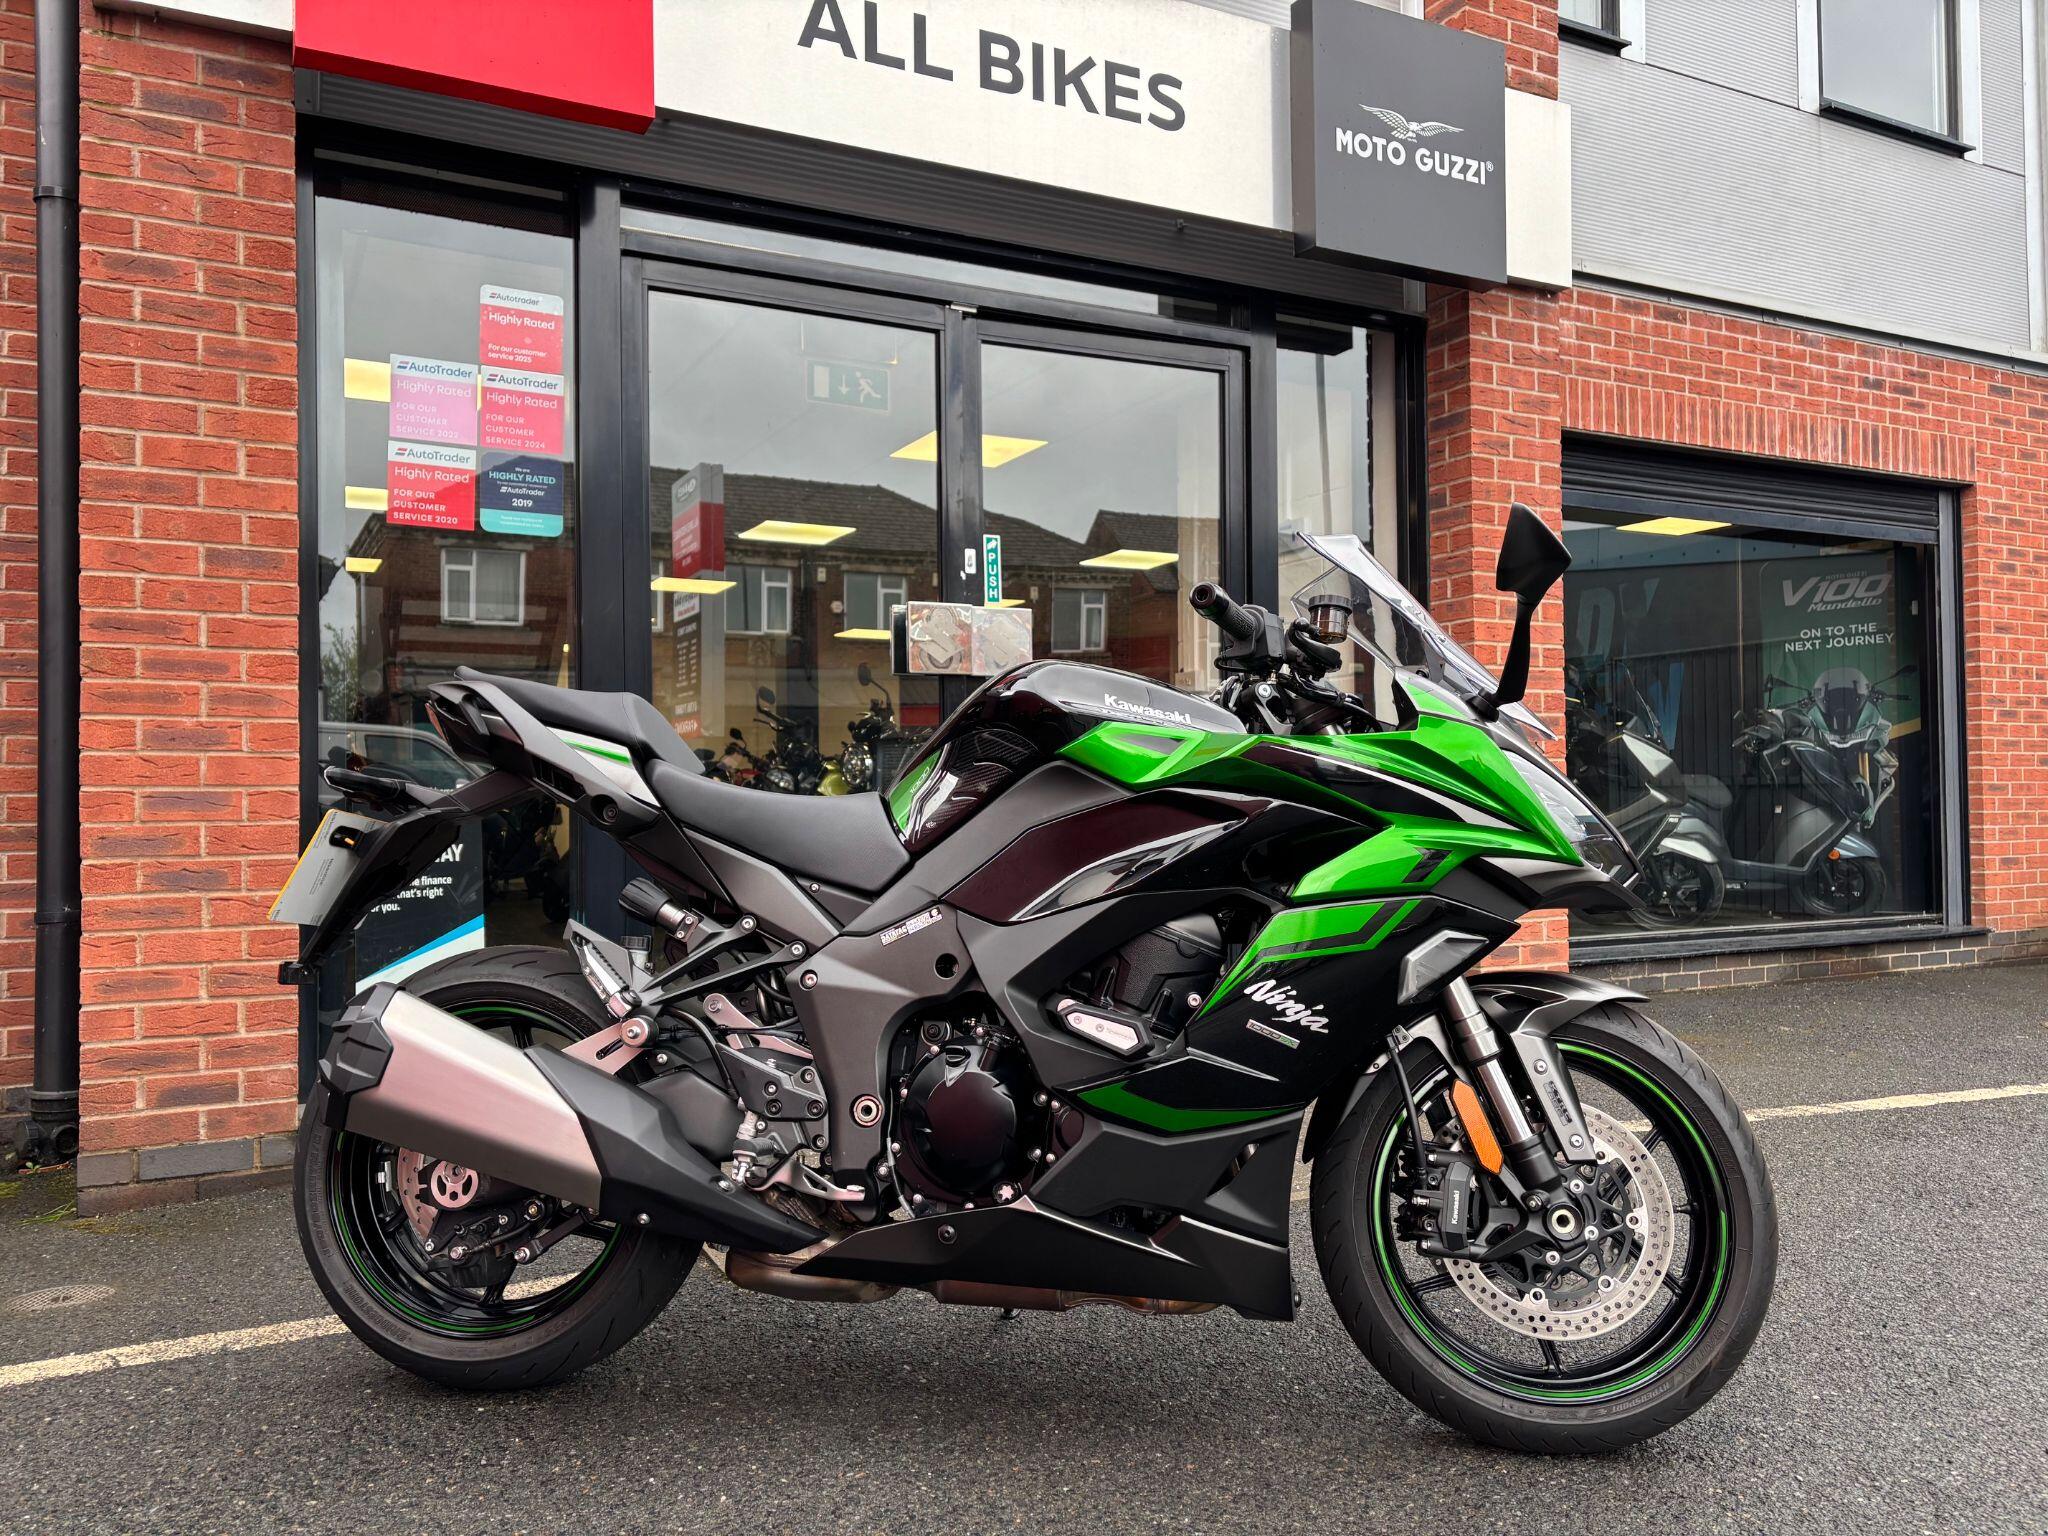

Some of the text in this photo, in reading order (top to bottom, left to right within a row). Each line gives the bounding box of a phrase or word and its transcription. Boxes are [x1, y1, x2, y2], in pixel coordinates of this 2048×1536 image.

[797, 0, 1187, 132] ALL BIKES
[1335, 127, 1407, 166] MOTO
[496, 293, 540, 306] Autotrader
[488, 311, 555, 330] Highly Rated
[488, 343, 500, 351] For
[513, 347, 547, 357] customer
[488, 352, 514, 361] service
[409, 362, 473, 378] AutoTrader
[396, 379, 472, 398] Highly Rated
[498, 375, 558, 390] AutoTrader
[486, 391, 557, 409] Highly Rated
[485, 413, 525, 424] FOR OUR
[485, 425, 535, 437] CUSTOMER
[485, 436, 545, 449] SERVICE 2024
[407, 448, 471, 464] AutoTrader
[394, 466, 470, 483] Highly Rated
[489, 471, 525, 482] HIGHLY
[525, 474, 556, 485] RATED
[393, 488, 435, 499] FOR OUR
[506, 487, 545, 496] AutoTrader
[393, 500, 446, 512] CUSTOMER
[512, 498, 533, 507] 2019
[393, 511, 458, 525] SERVICE 2020
[988, 552, 998, 599] PUSH
[1782, 573, 1892, 606] V100
[1800, 622, 1877, 639] ON TO THE
[1785, 632, 1895, 653] NEXT JOURNEY
[1103, 693, 1192, 725] Kawasaki
[421, 876, 452, 886] finance
[422, 887, 444, 899] right
[381, 903, 400, 914] you.
[1243, 979, 1330, 1034] Ninja
